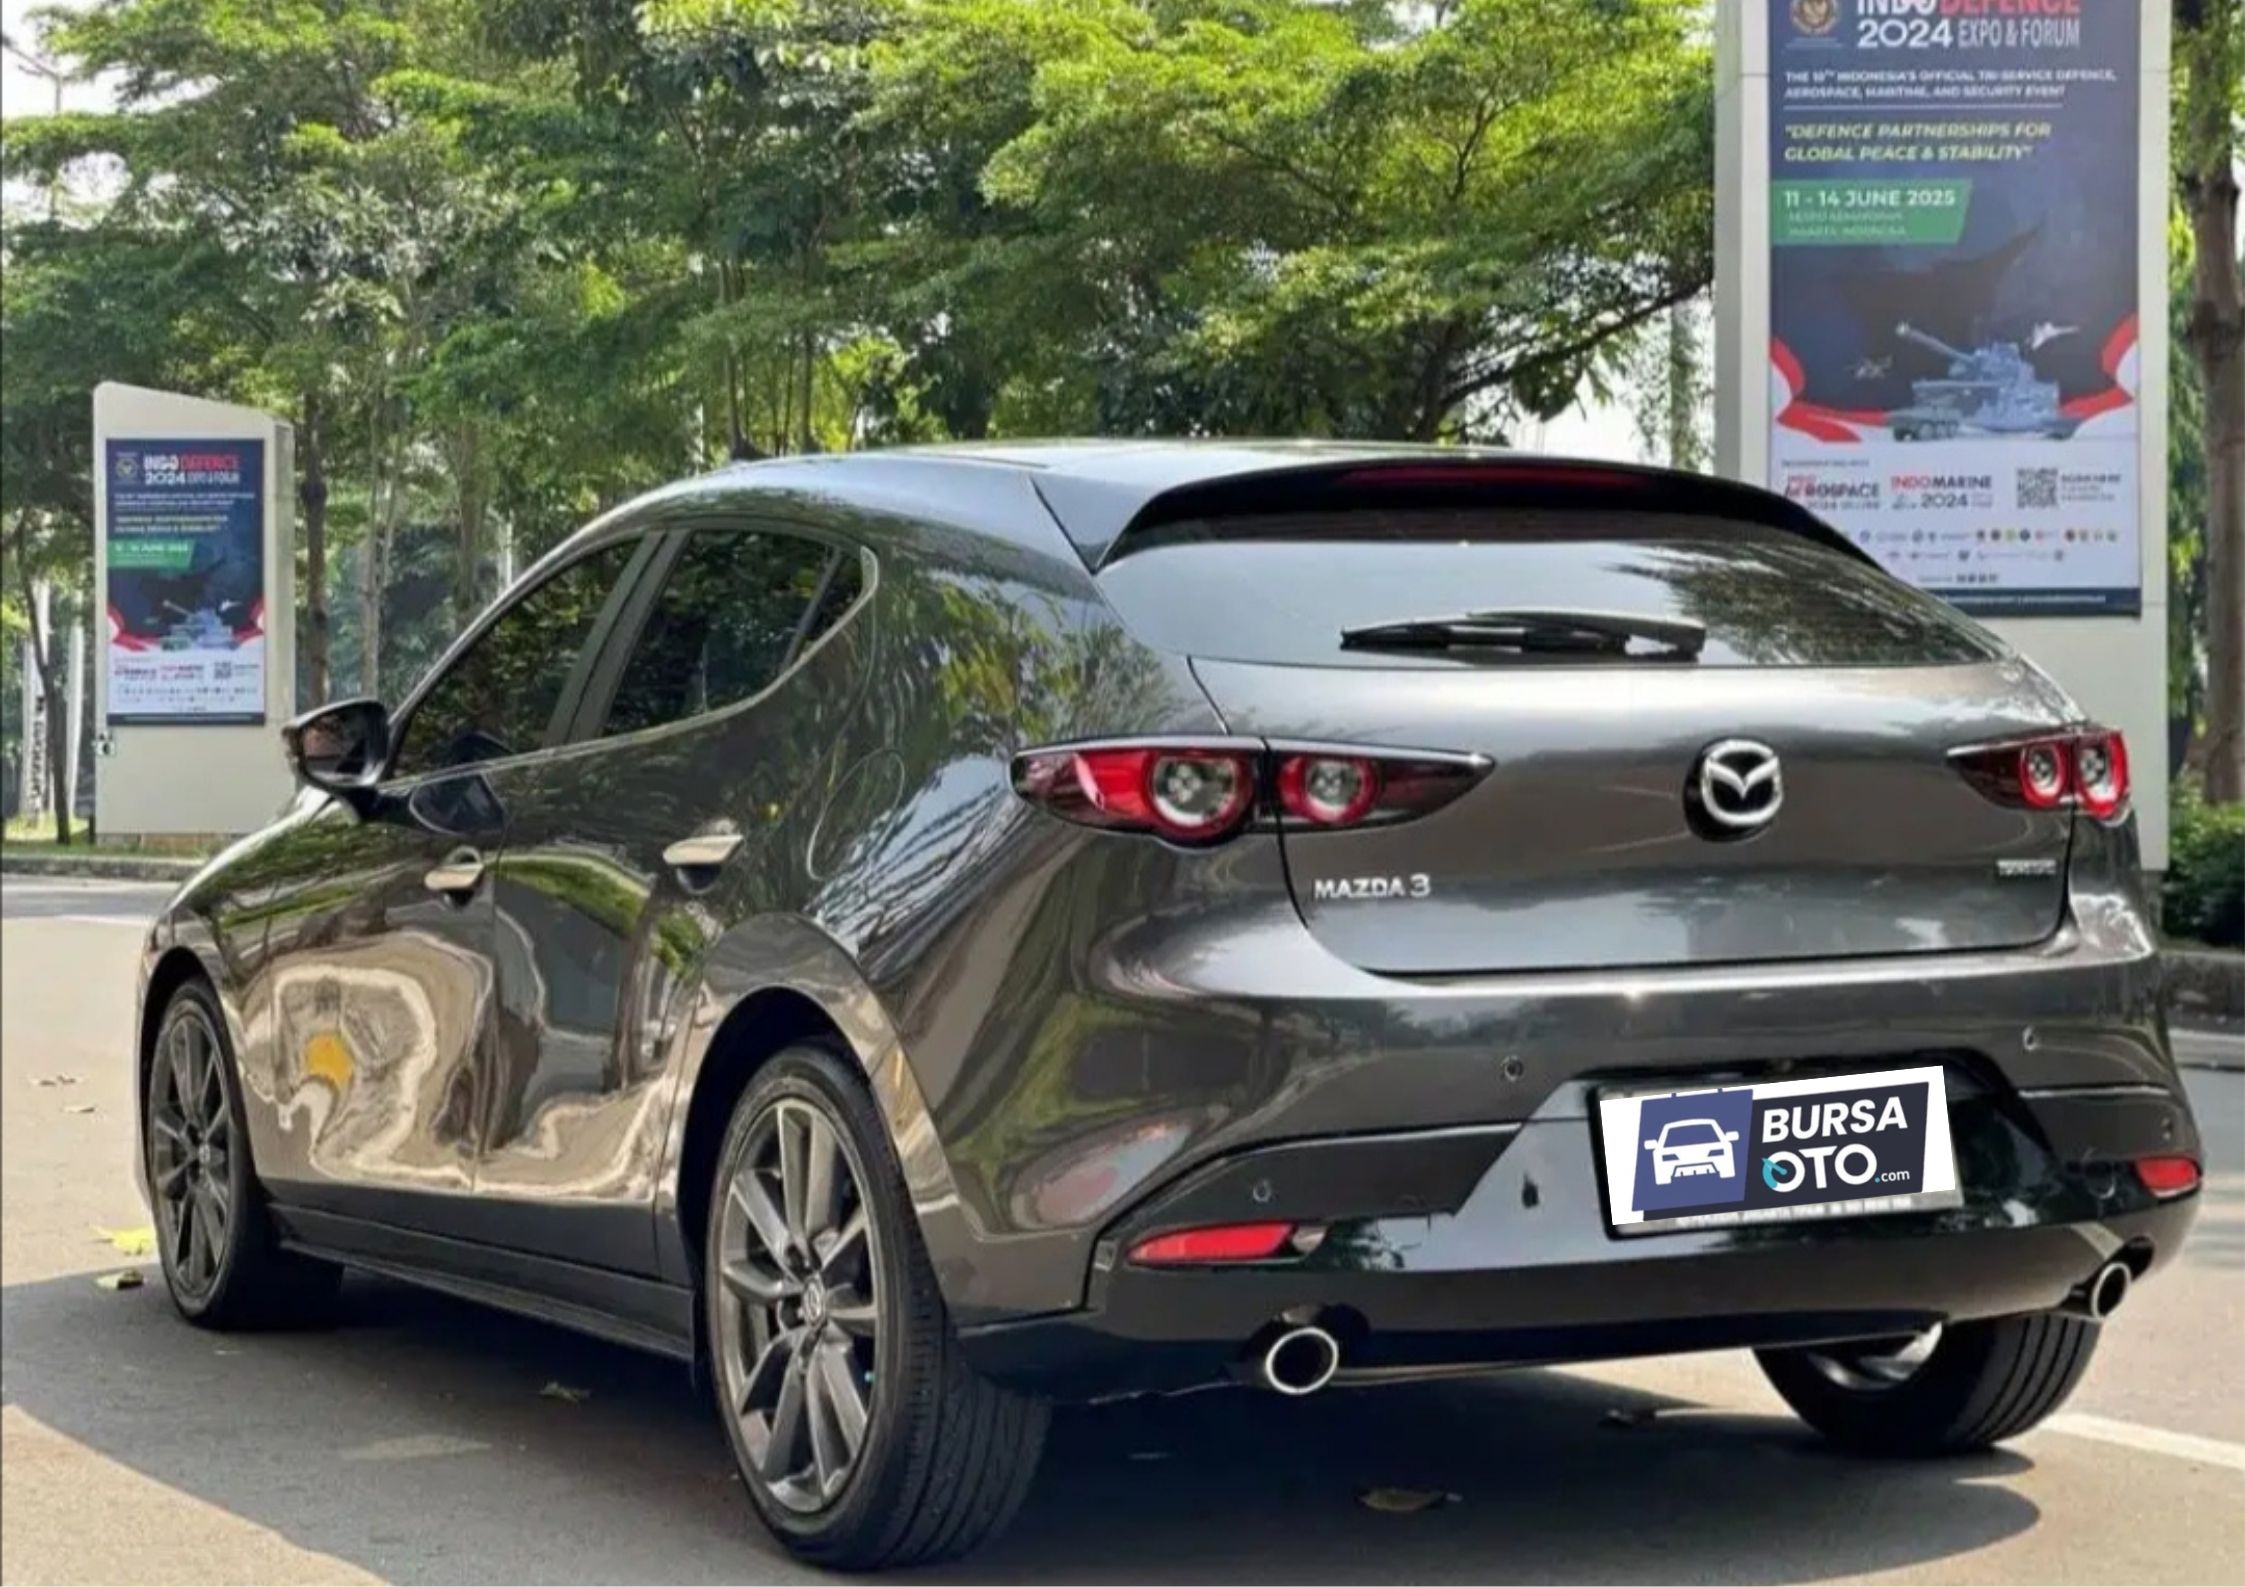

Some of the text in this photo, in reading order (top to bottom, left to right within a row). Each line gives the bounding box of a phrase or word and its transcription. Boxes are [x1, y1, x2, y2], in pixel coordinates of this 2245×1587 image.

[1857, 18, 2081, 48] 2024 EXPO & FORUM
[1932, 86, 1960, 97] AND
[1963, 85, 2022, 97] SECURITY
[2025, 85, 2066, 97] EVENT
[1878, 122, 2010, 138] PARTNERSHIPS
[2014, 122, 2052, 138] FOR
[1784, 146, 1854, 161] GLOBAL
[1859, 146, 1917, 160] PEACE
[1785, 190, 1801, 207] 11
[1819, 190, 1840, 207] 14
[1845, 189, 1900, 207] JUNE
[1906, 189, 1955, 206] 2025
[1921, 493, 1969, 508] 2024
[1314, 872, 1431, 899] MAZDA 3
